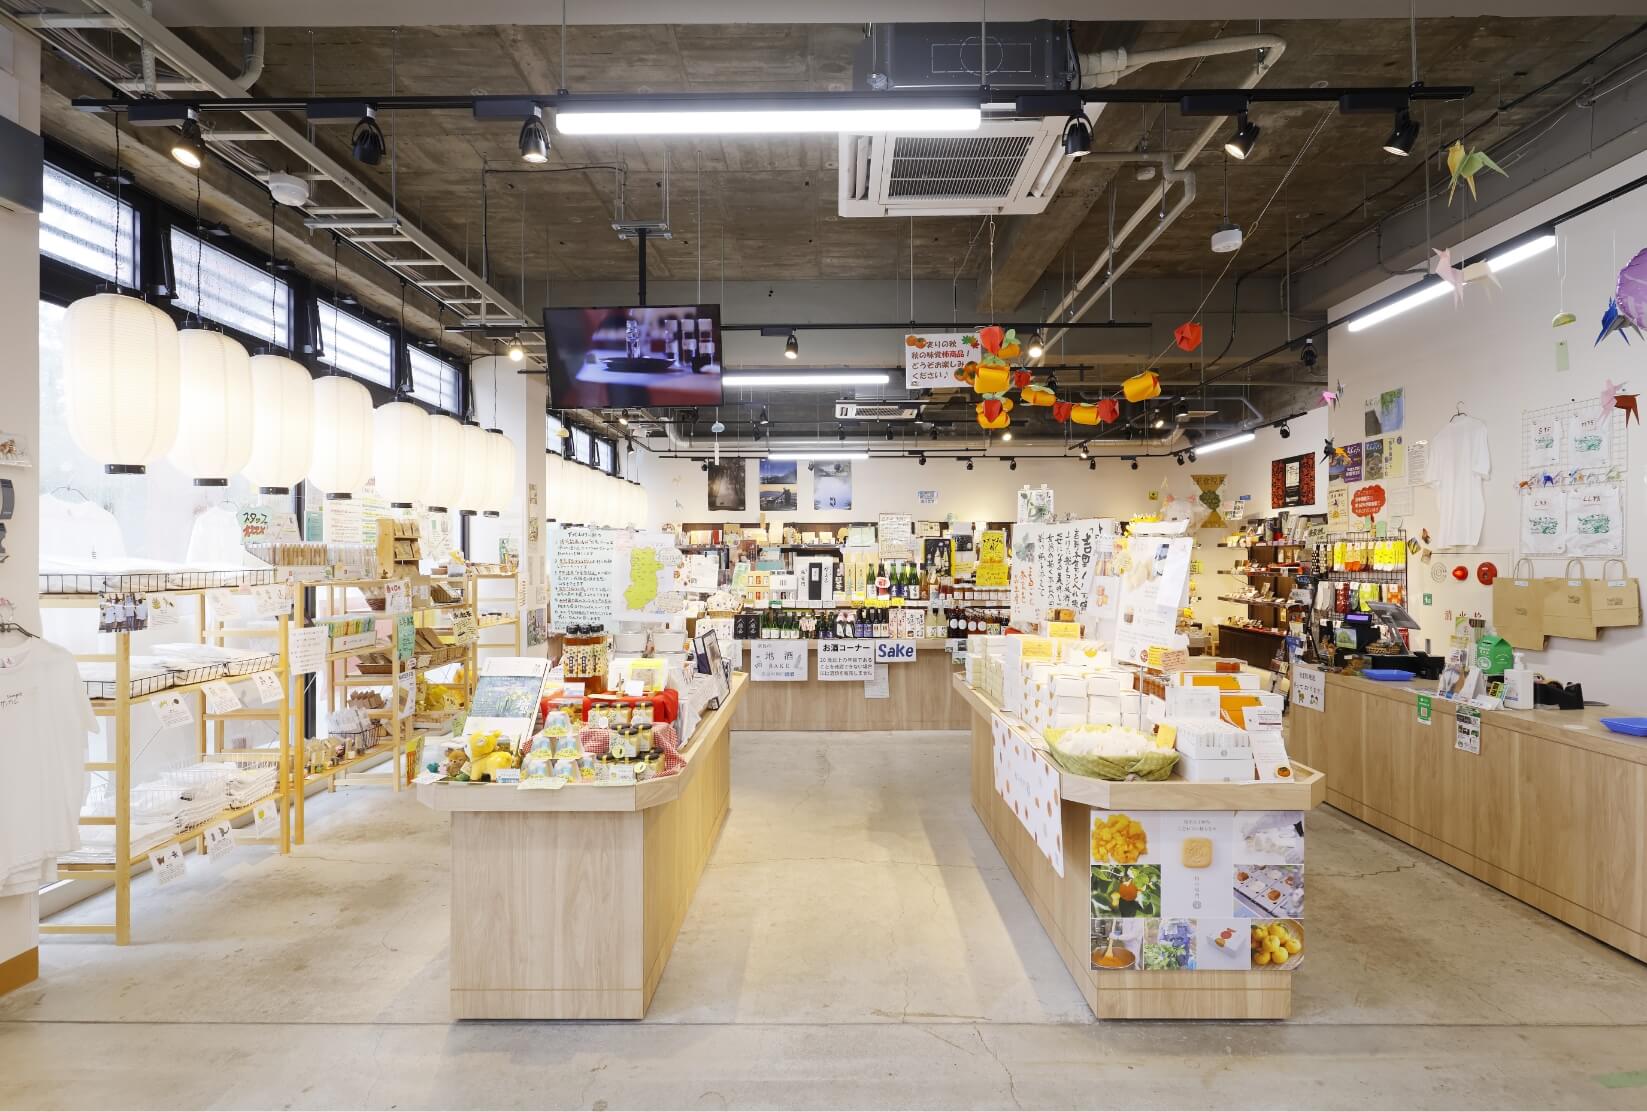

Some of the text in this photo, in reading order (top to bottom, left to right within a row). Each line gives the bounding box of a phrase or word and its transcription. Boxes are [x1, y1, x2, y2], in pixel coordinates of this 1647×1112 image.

[242, 512, 268, 524] スタッフ
[822, 643, 871, 652] お酒コーナー
[878, 643, 914, 658] Sake
